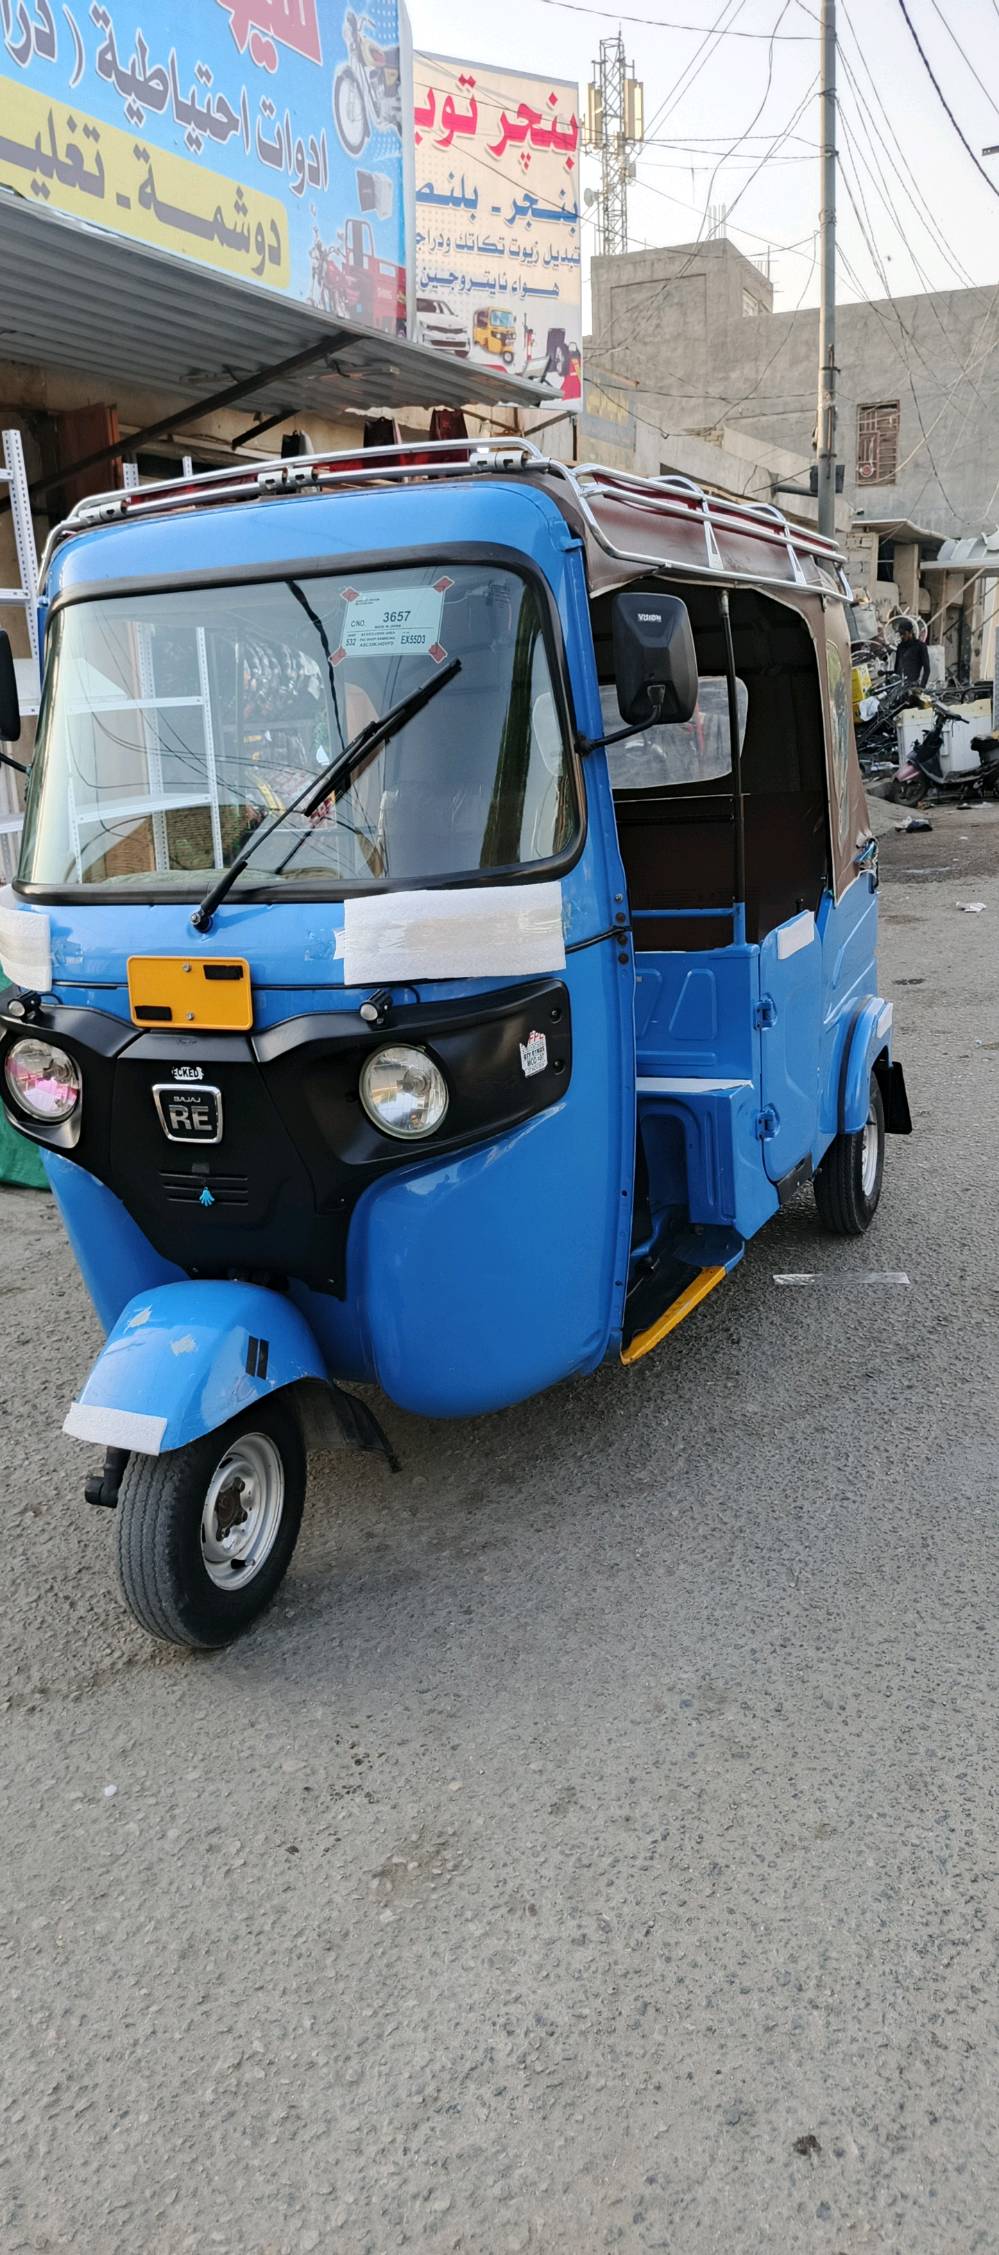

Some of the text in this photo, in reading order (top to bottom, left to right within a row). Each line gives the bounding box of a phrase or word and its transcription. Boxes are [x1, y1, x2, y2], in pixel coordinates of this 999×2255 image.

[90, 0, 250, 154] احتياطية
[0, 106, 106, 200] تغلي
[256, 93, 328, 197] ادوات
[416, 229, 450, 253] ودراج
[382, 610, 411, 623] 3657
[168, 1104, 213, 1131] RE
